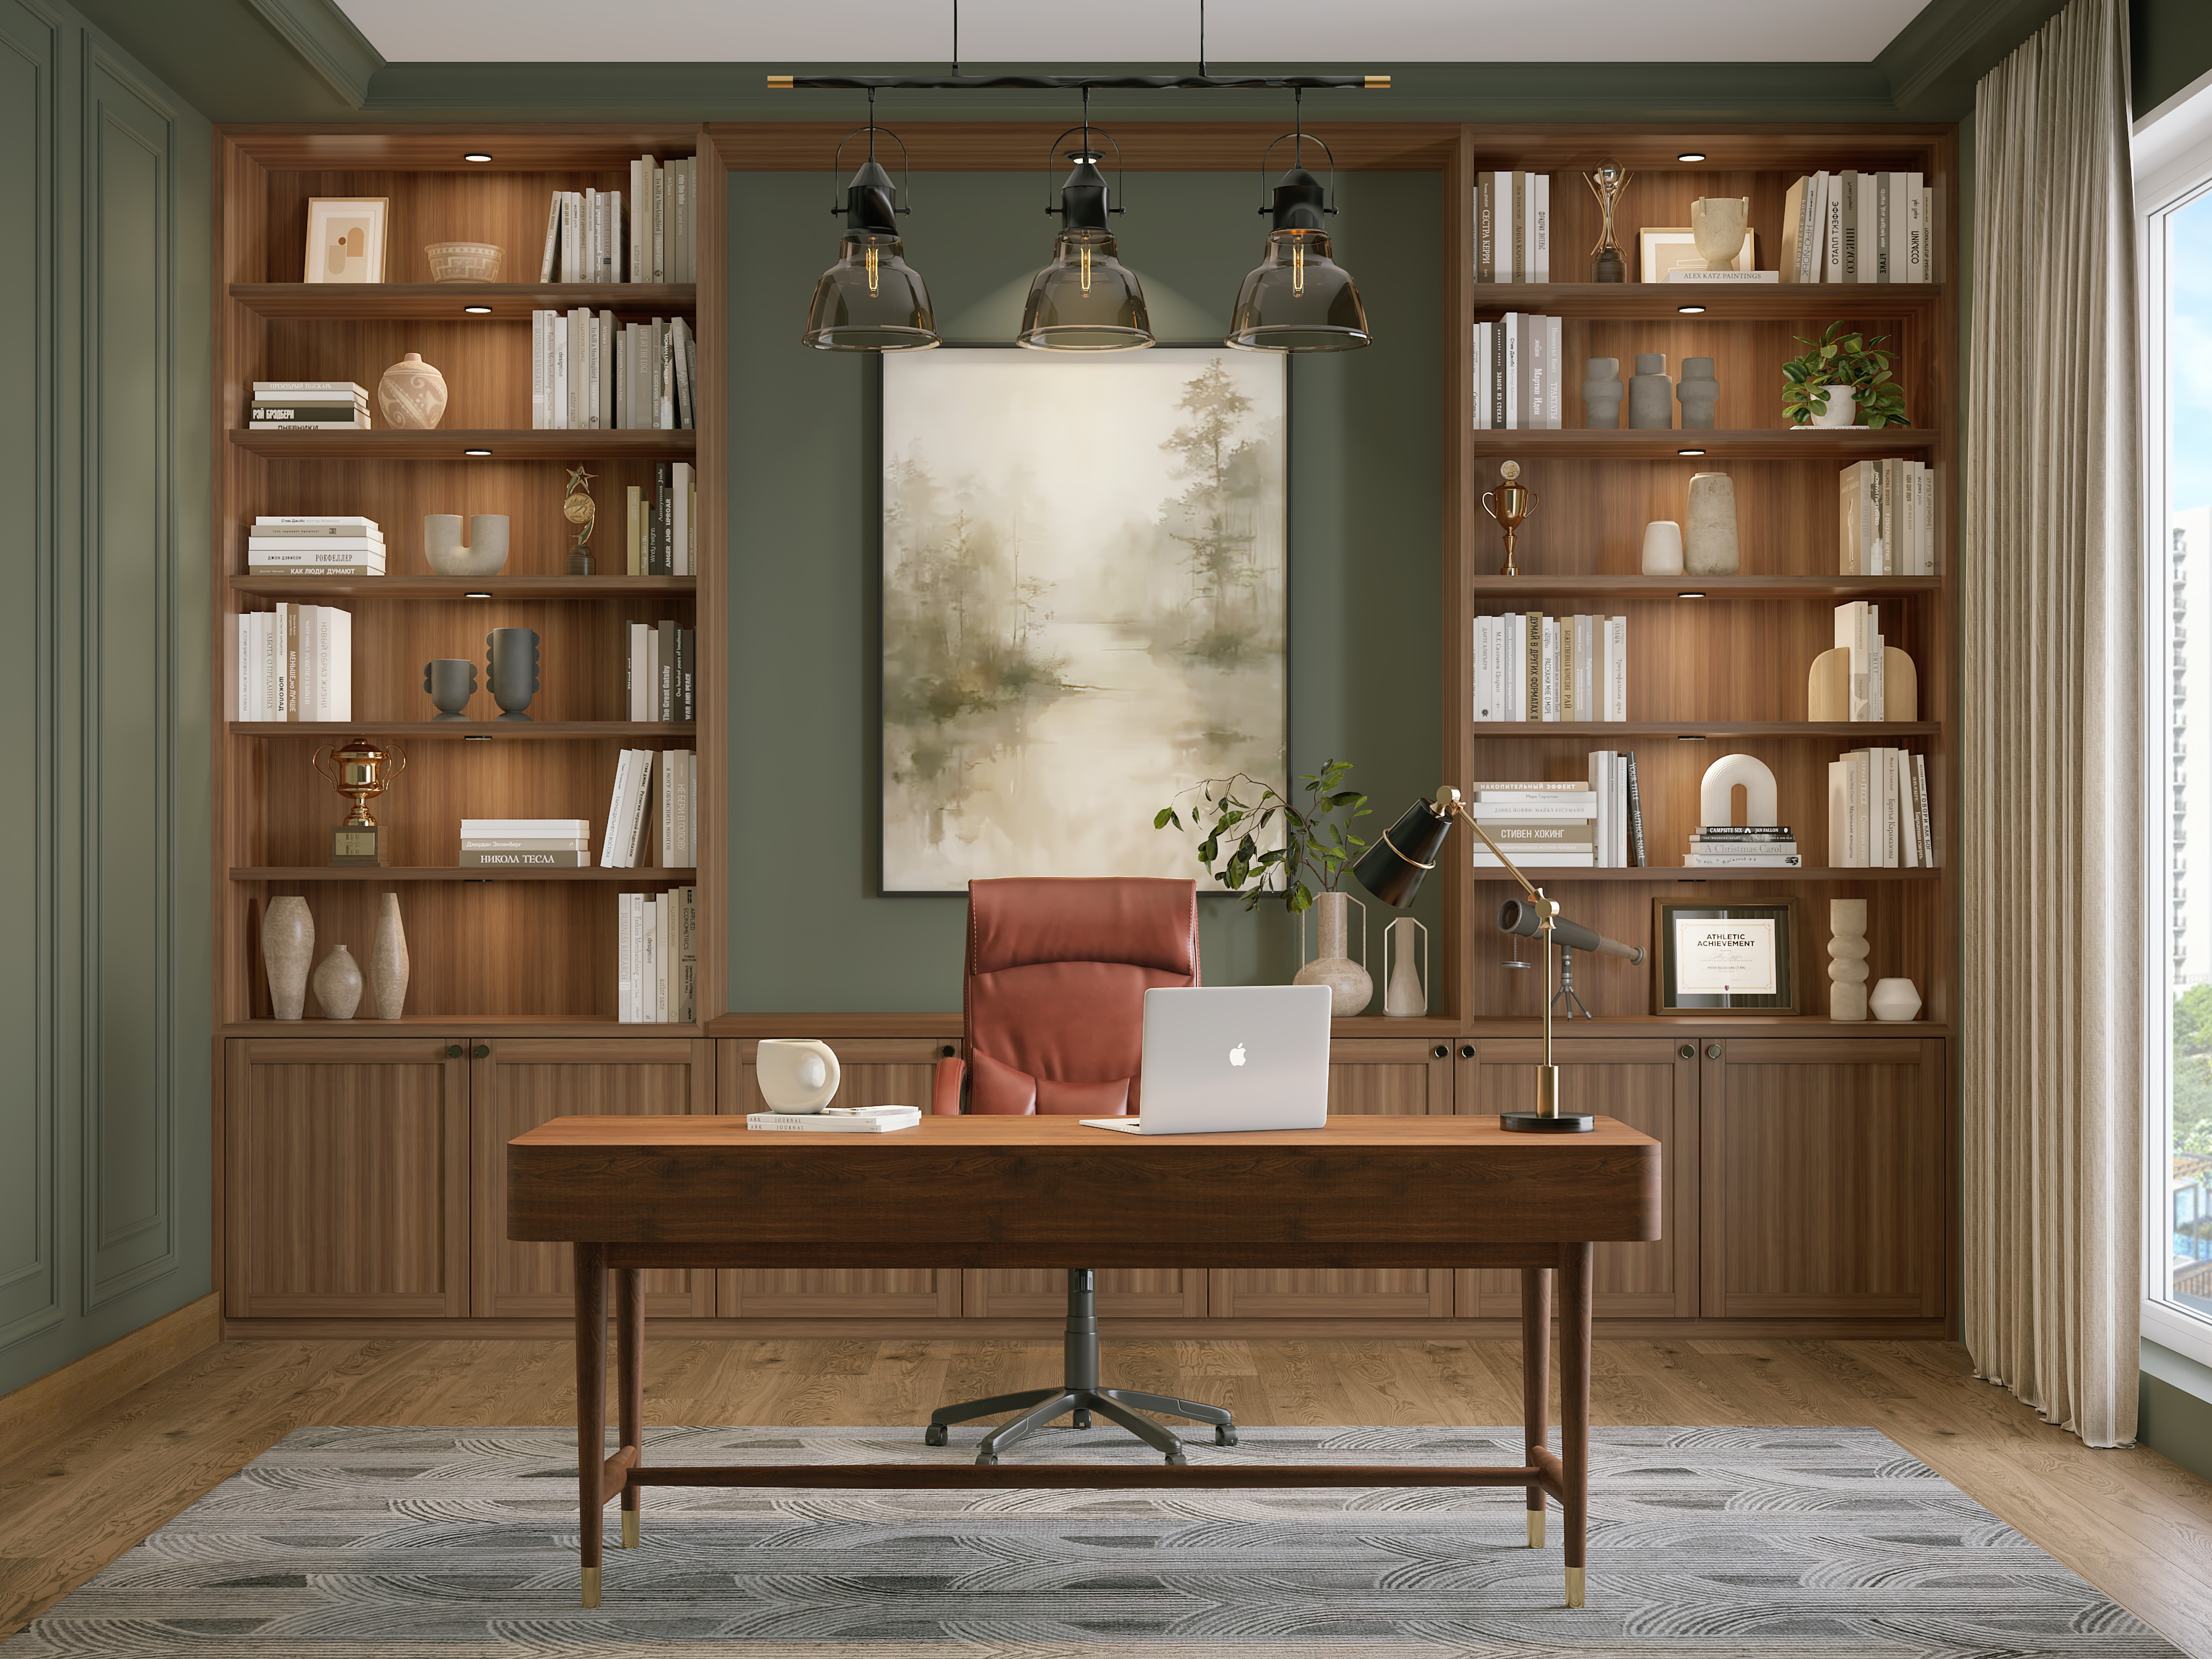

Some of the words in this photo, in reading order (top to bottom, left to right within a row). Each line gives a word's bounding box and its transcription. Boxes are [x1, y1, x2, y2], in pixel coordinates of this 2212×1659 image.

[1533, 369, 1542, 394] Мартин
[253, 408, 264, 419] РЭЙ
[266, 409, 294, 419] БРЭДБЕРИ
[1533, 398, 1542, 415] Иден
[1529, 616, 1540, 640] ДУМАЙ
[1529, 649, 1538, 675] ДРУГИХ
[1564, 695, 1572, 708] РАЙ
[1629, 763, 1637, 782] YOUR
[678, 785, 685, 794] НЕ
[1887, 799, 1895, 820] Братья
[609, 812, 618, 836] ДАЛЬНЕГО
[1501, 830, 1532, 838] СТИВЕН
[1535, 830, 1565, 838] ХОКИНГ
[1634, 811, 1643, 838] AUTHOR
[1887, 822, 1895, 859] Карамазовы
[481, 855, 519, 863] НИКОЛА
[523, 855, 555, 863] ТЕСЛА
